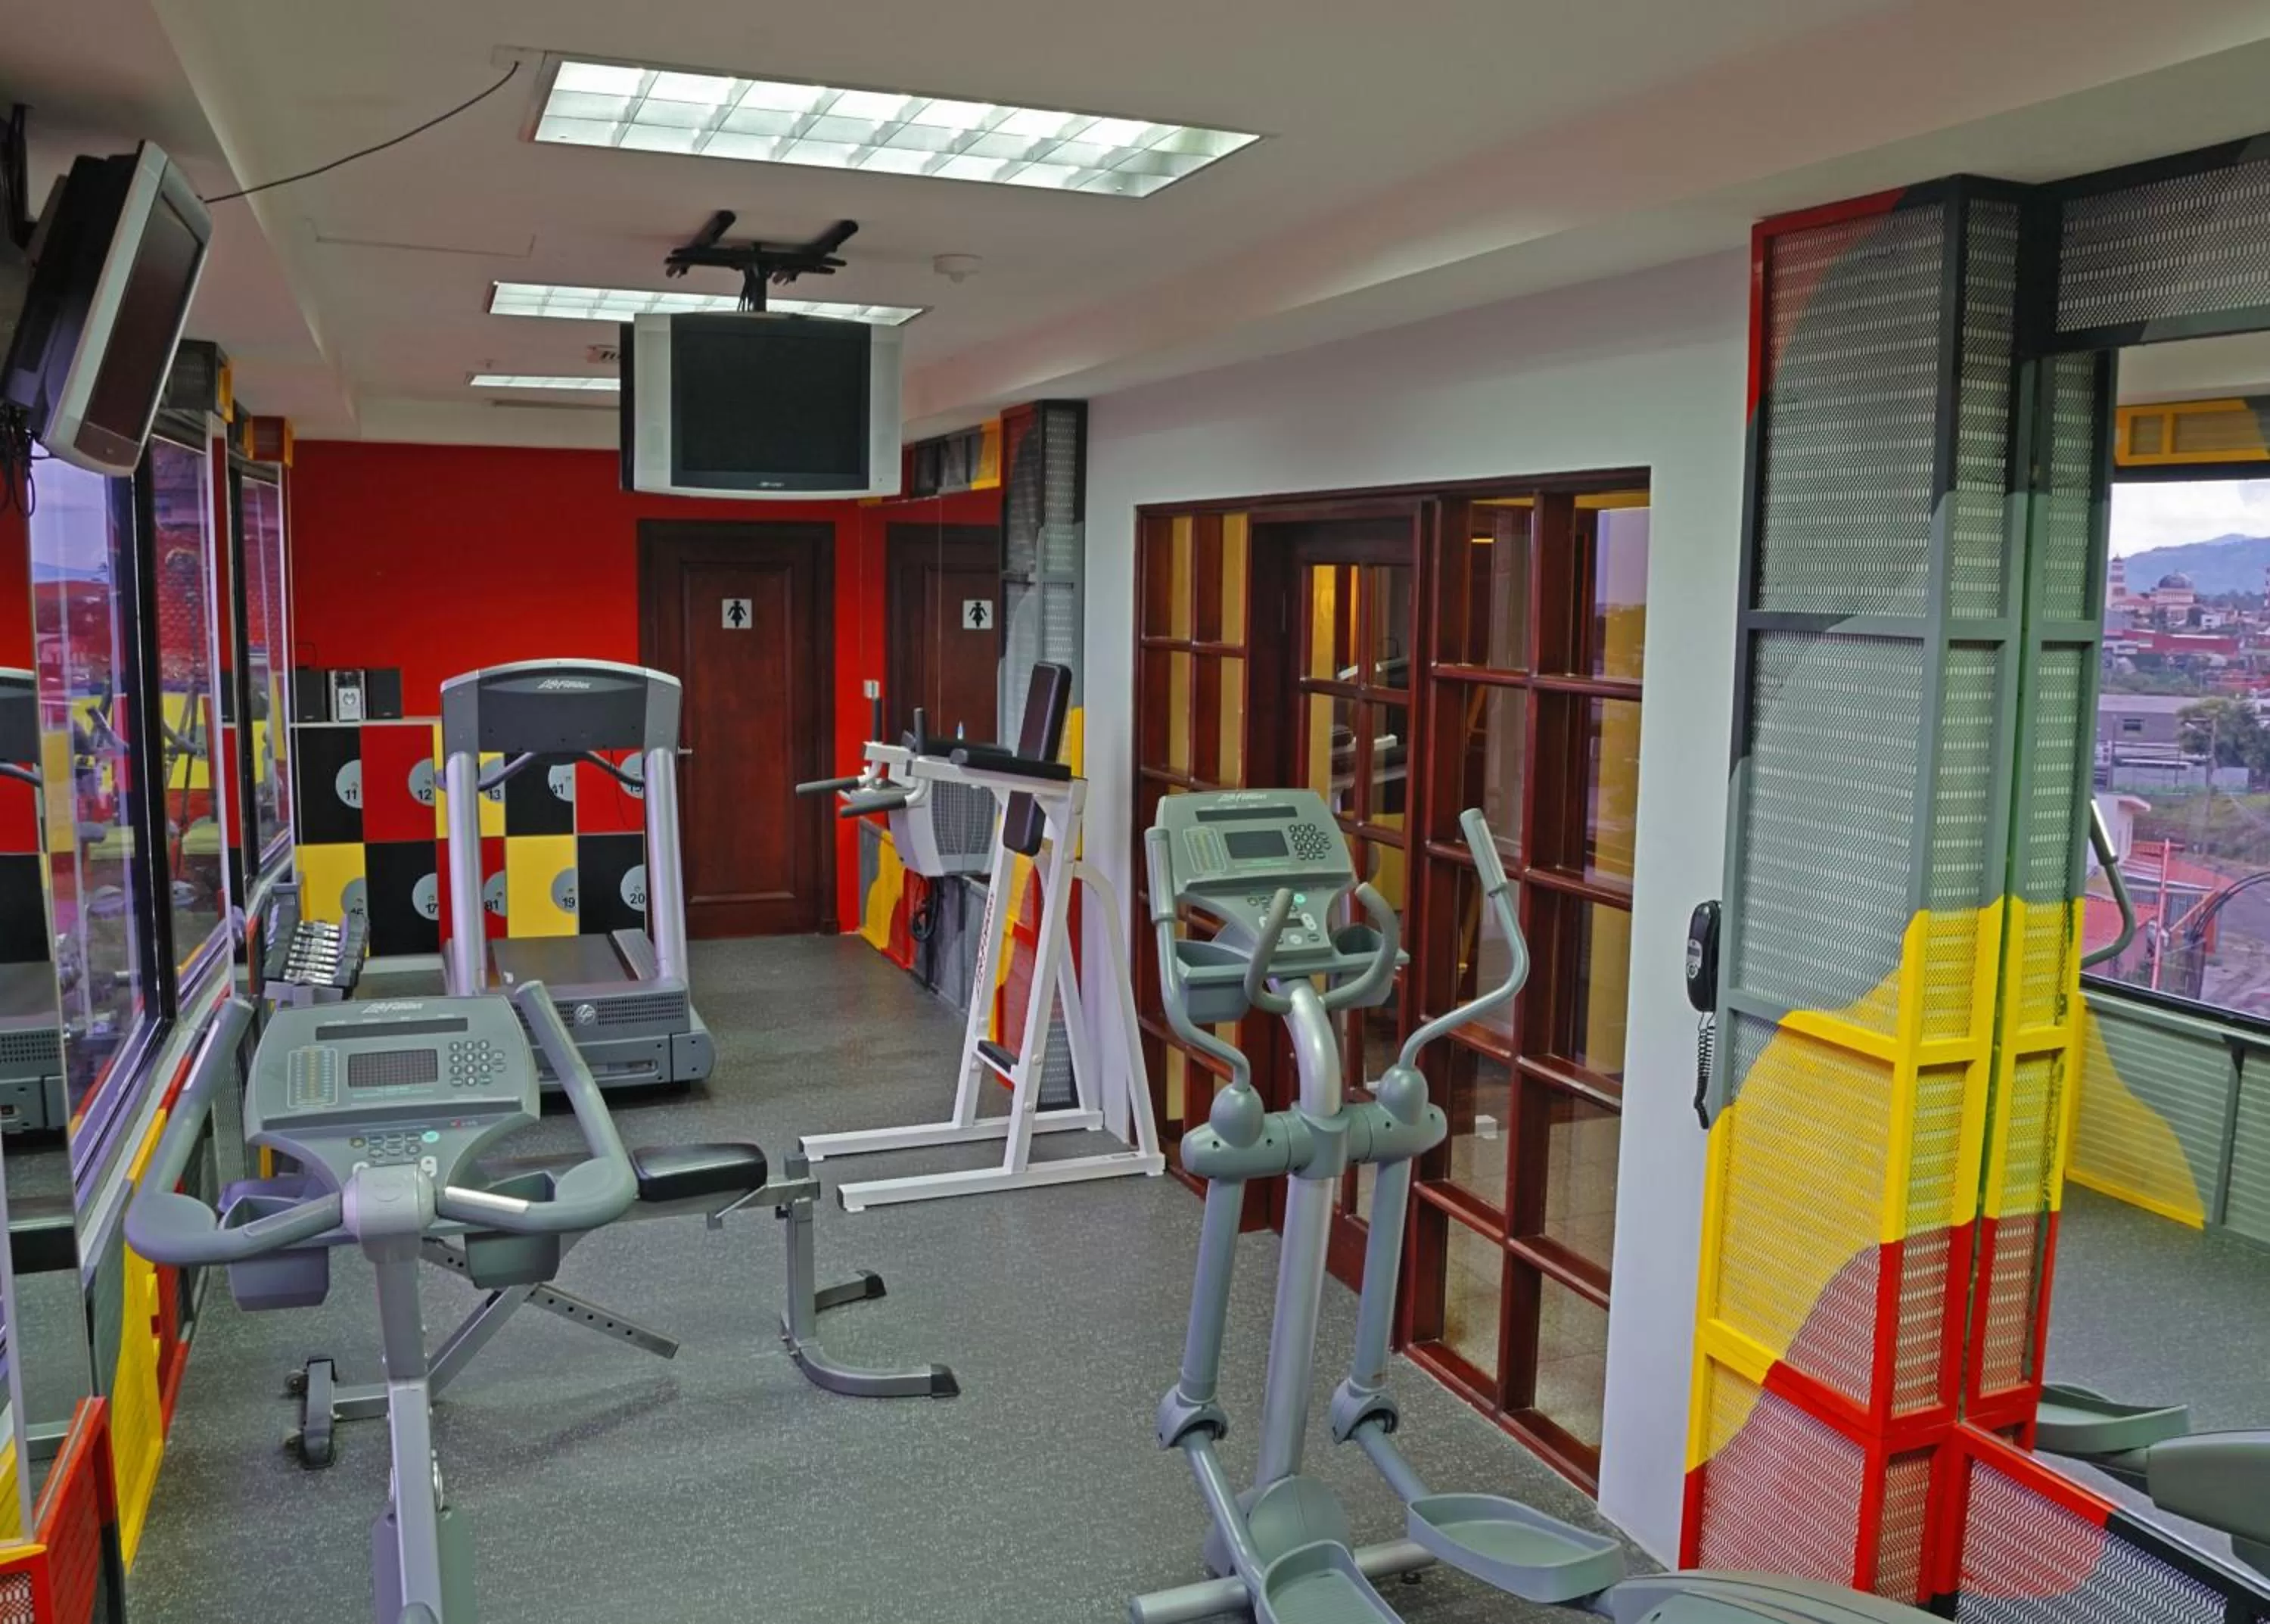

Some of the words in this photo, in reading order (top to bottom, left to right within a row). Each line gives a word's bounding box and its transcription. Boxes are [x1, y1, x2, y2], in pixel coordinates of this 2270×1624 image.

[345, 789, 356, 800] 11
[418, 789, 432, 800] 12
[488, 789, 501, 800] 13
[561, 897, 576, 908] 19
[630, 892, 645, 904] 20
